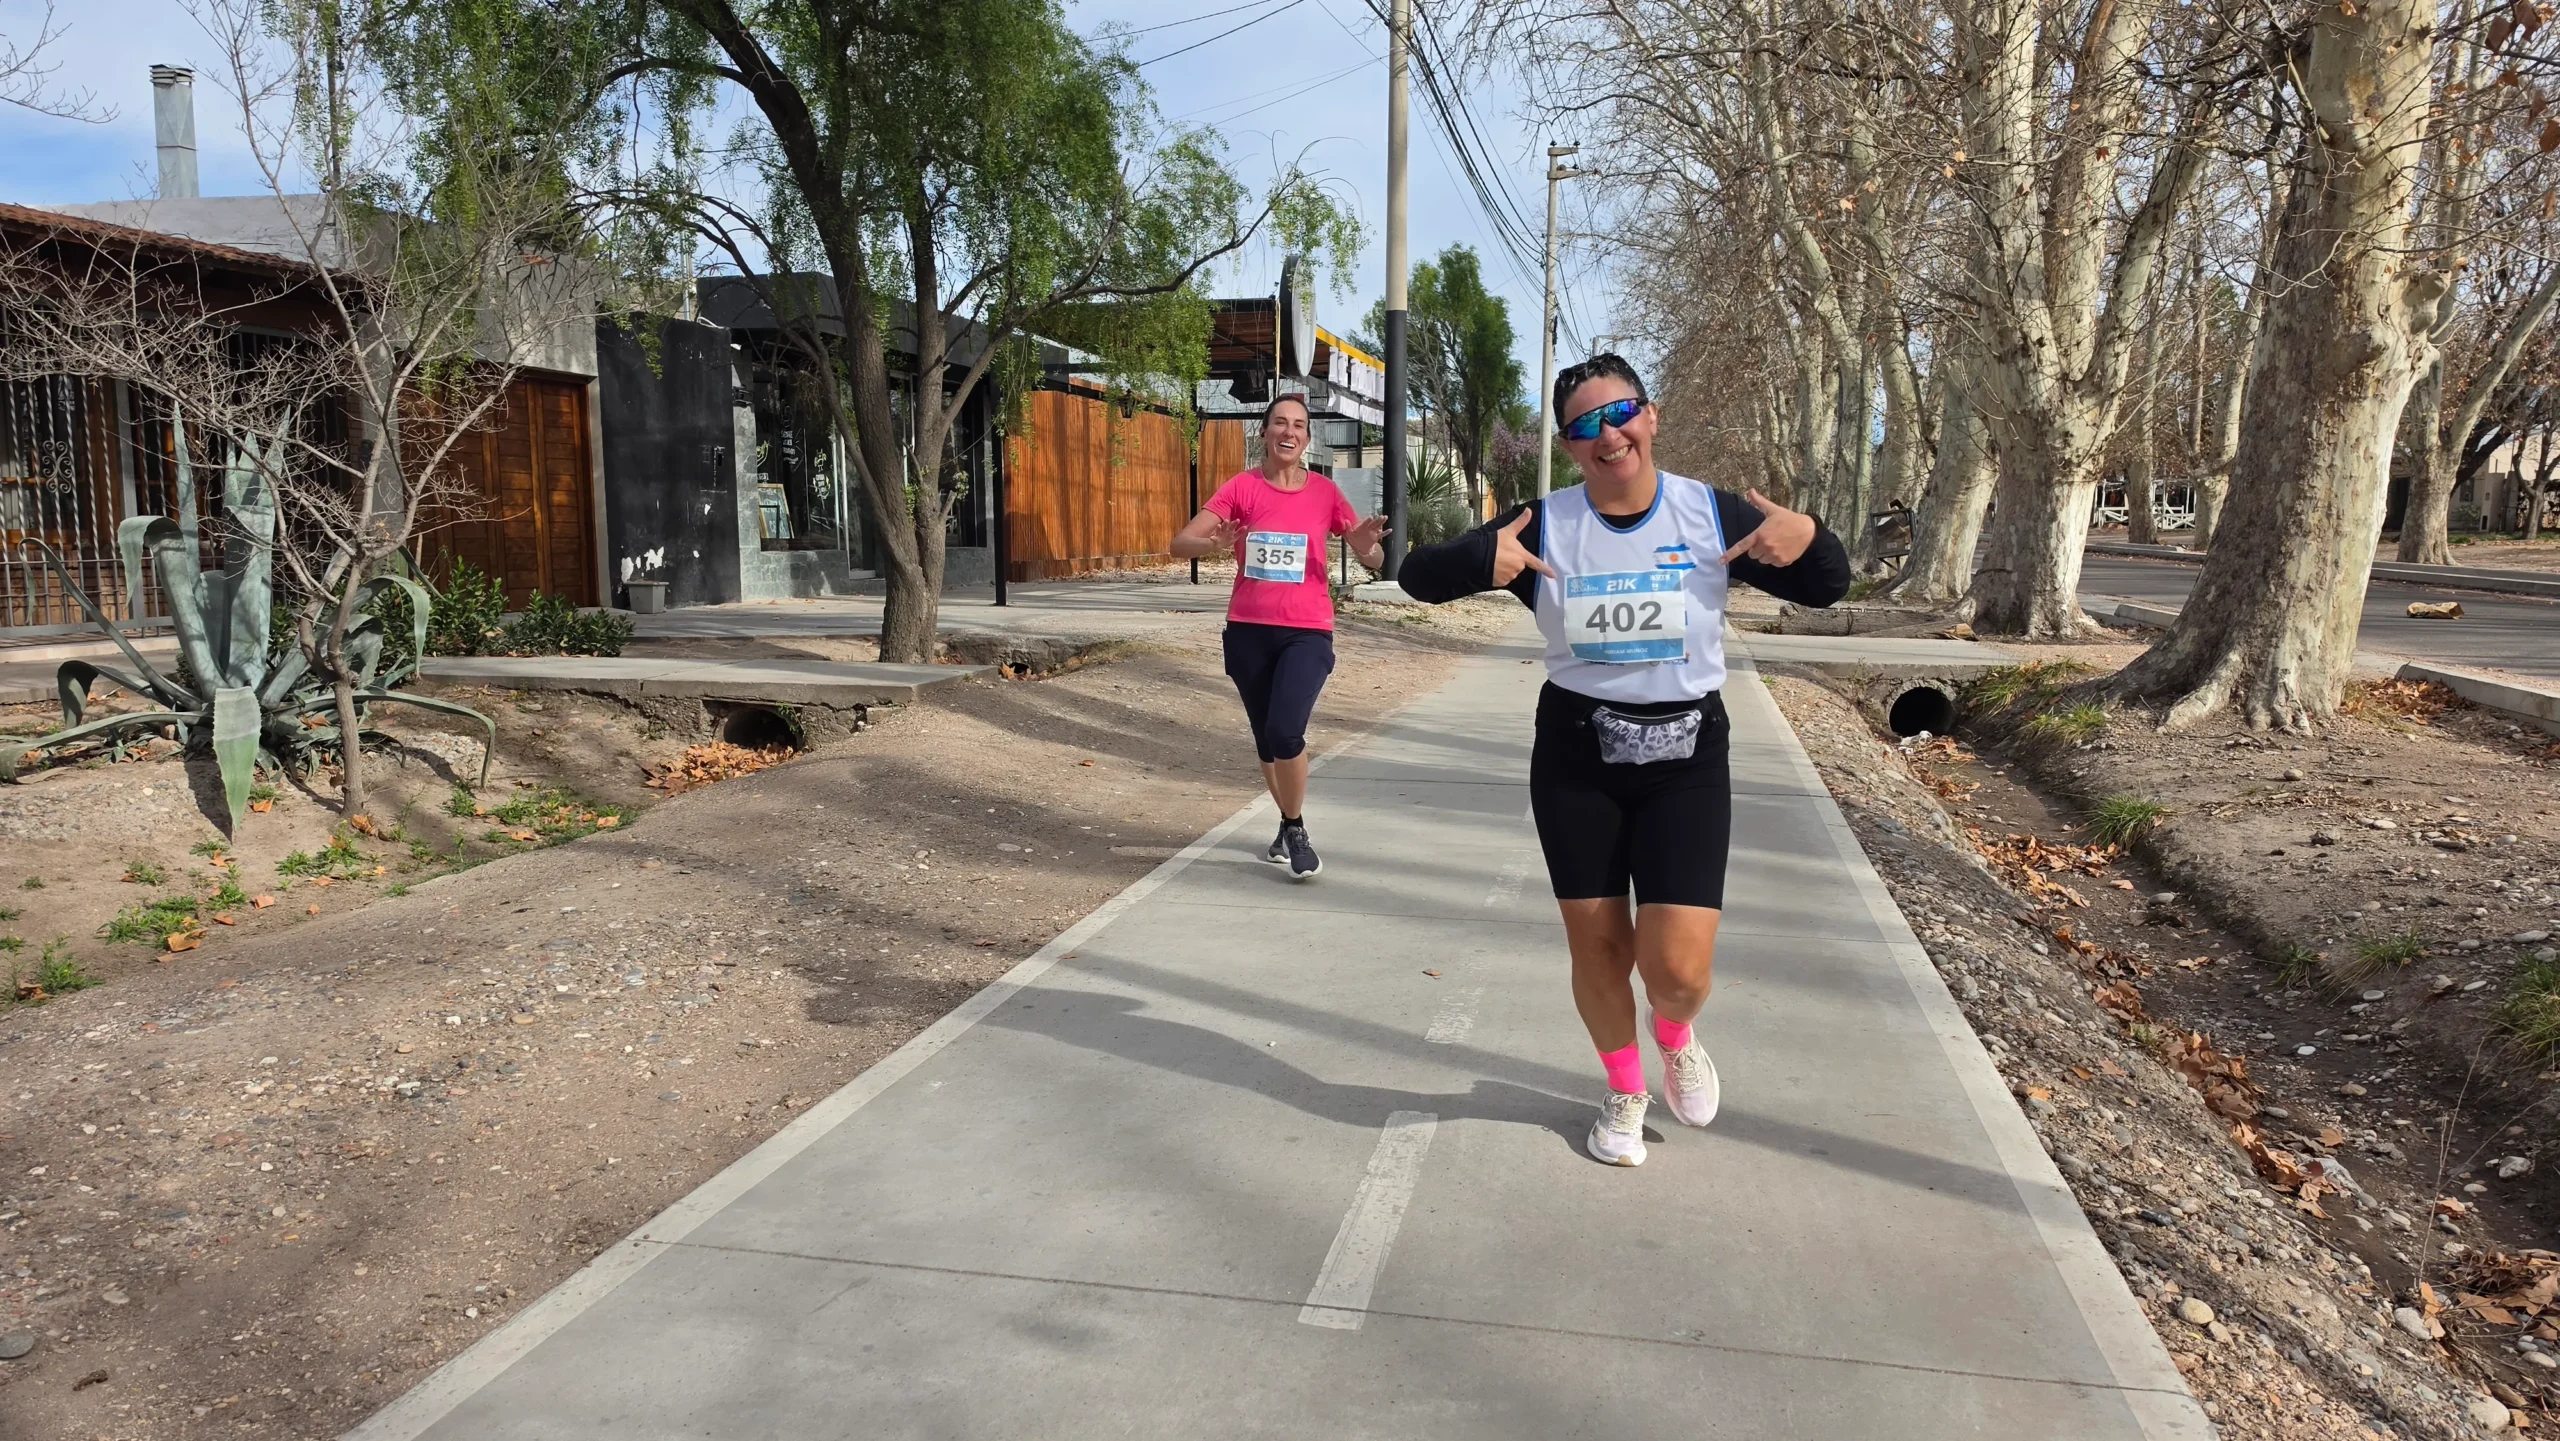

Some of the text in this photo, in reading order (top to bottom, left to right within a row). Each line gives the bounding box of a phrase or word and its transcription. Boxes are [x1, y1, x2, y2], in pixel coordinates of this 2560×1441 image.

[1268, 536, 1284, 544] 21K
[1256, 548, 1294, 565] 355
[1606, 578, 1637, 591] 21K
[1585, 601, 1663, 633] 402
